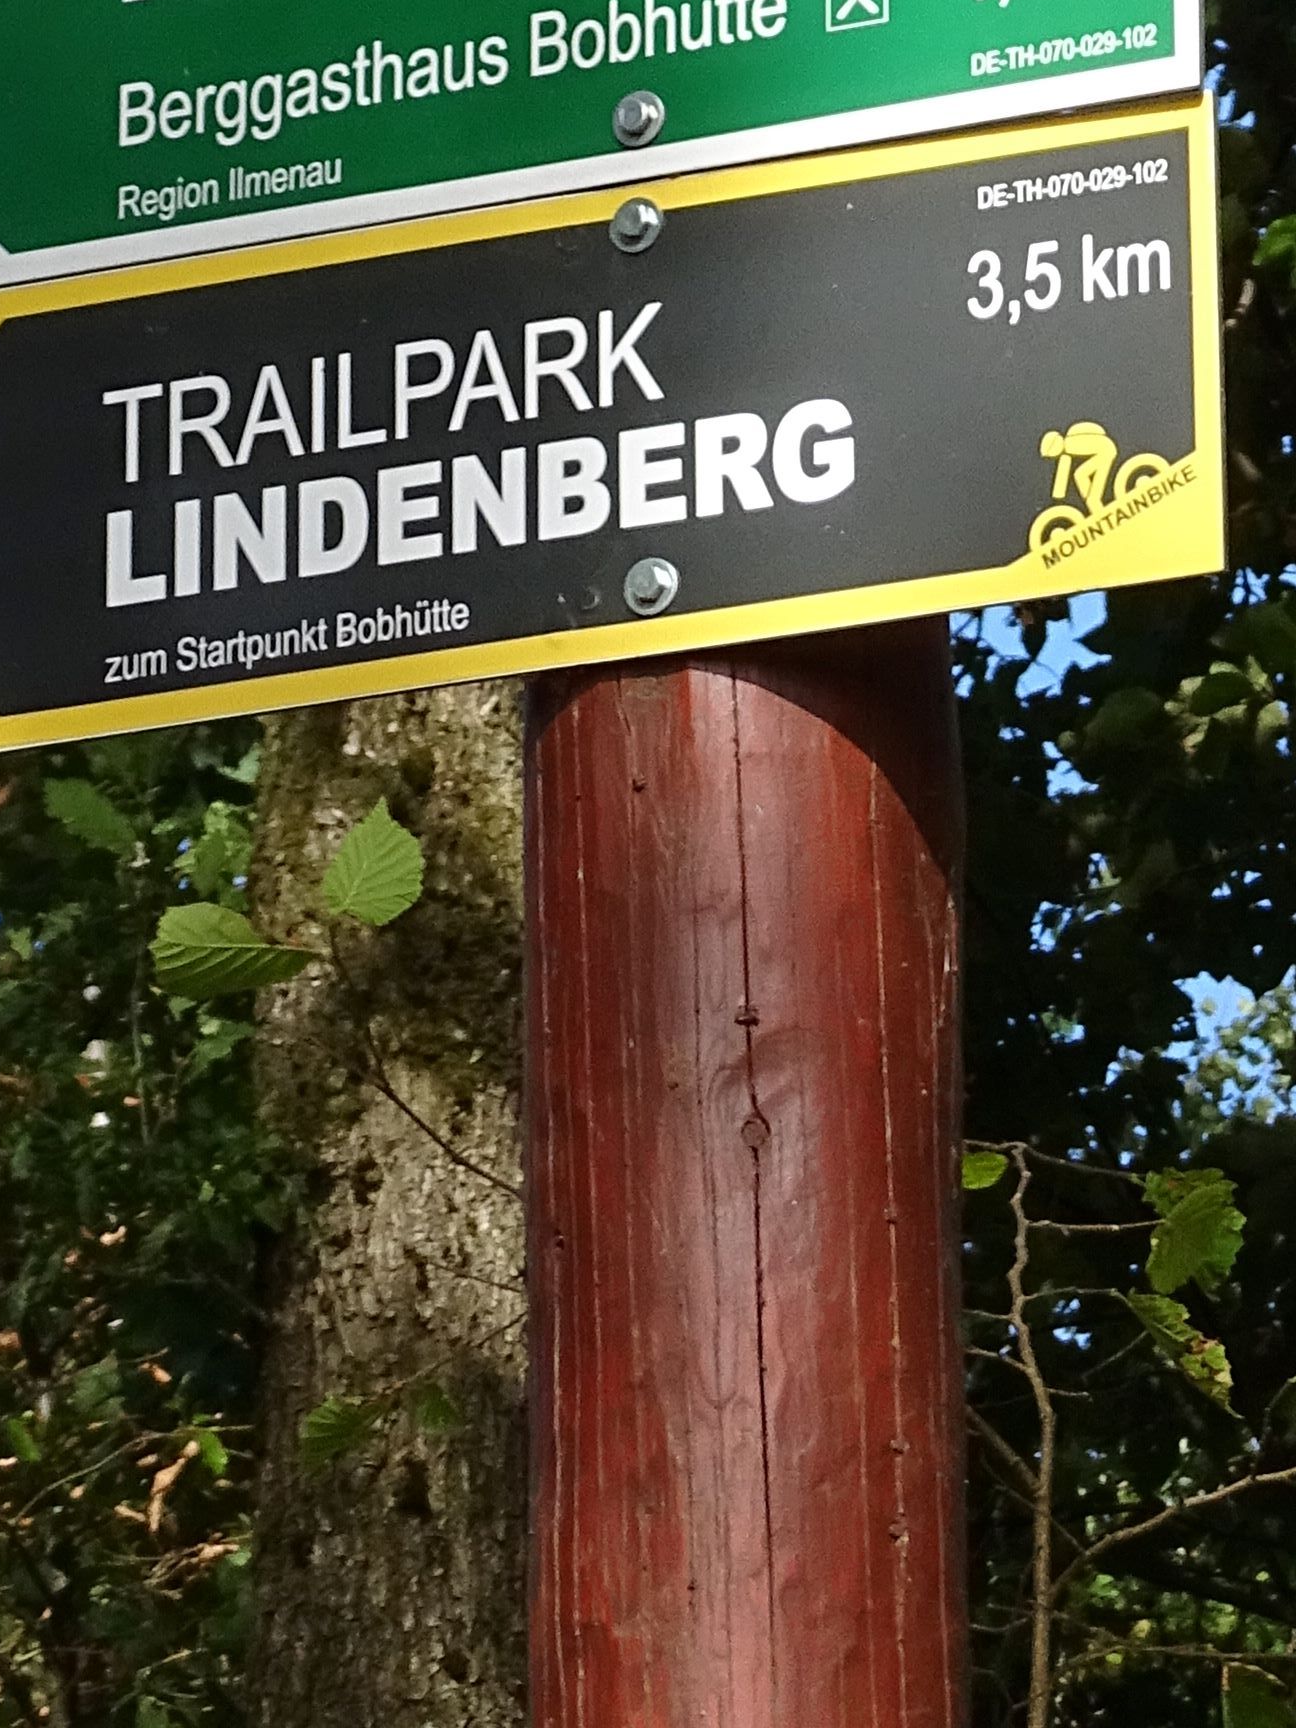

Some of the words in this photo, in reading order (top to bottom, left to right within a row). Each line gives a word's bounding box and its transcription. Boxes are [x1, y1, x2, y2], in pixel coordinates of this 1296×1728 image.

[119, 36, 508, 146] Berggasthaus
[971, 23, 1157, 76] DE-TH-070-029-102
[118, 177, 219, 220] Region
[229, 159, 341, 200] Ilmenau
[978, 159, 1168, 209] DE-TH-070-029-102
[968, 240, 1061, 324] 3,5
[1082, 234, 1170, 301] km
[103, 302, 664, 482] TRAILPARK
[106, 399, 855, 608] LINDENBERG
[1042, 465, 1197, 569] MOUNTAINBIKE
[105, 647, 166, 683] zum
[177, 619, 328, 671] Startpunkt
[337, 599, 469, 647] Bobhütte
